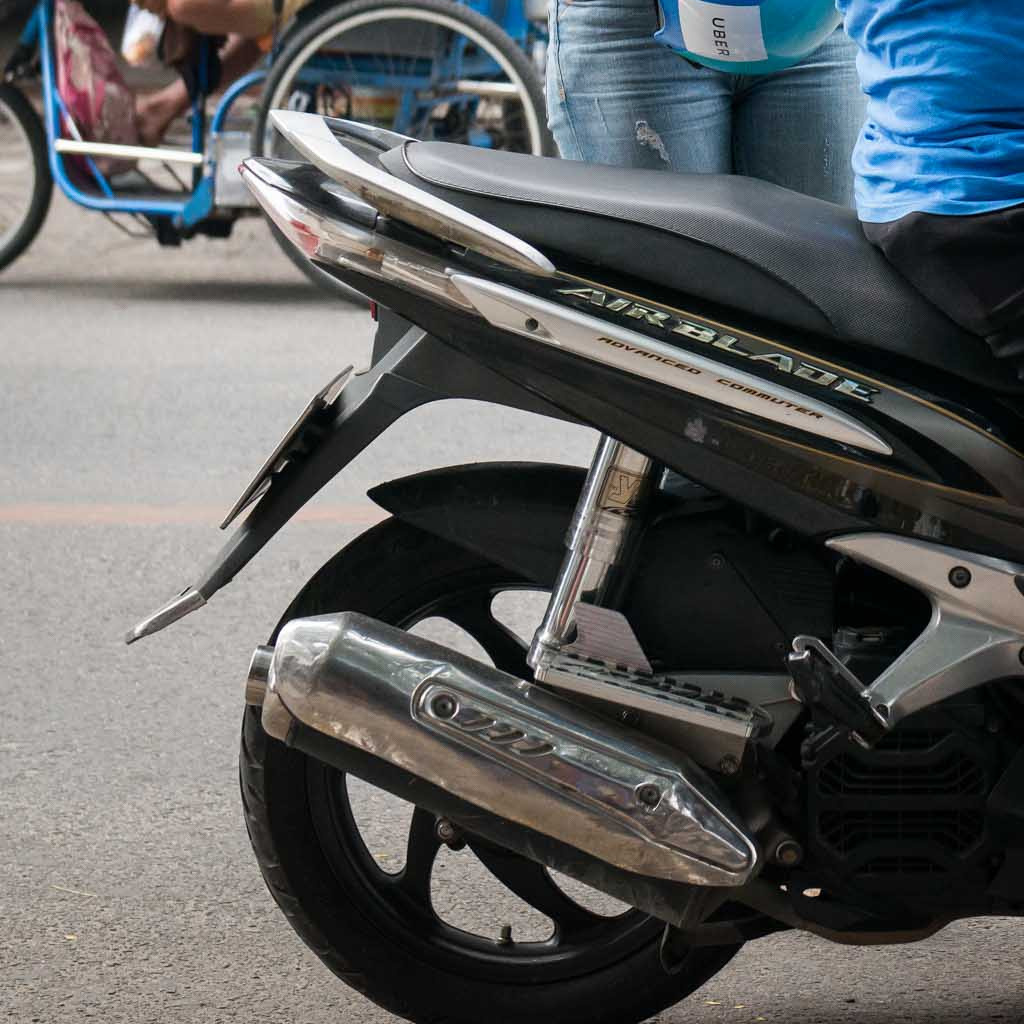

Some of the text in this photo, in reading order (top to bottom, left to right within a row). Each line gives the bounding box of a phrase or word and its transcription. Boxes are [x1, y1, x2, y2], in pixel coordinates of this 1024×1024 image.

[712, 17, 730, 57] UBER
[597, 337, 824, 419] ADVANCED COMMUTER
